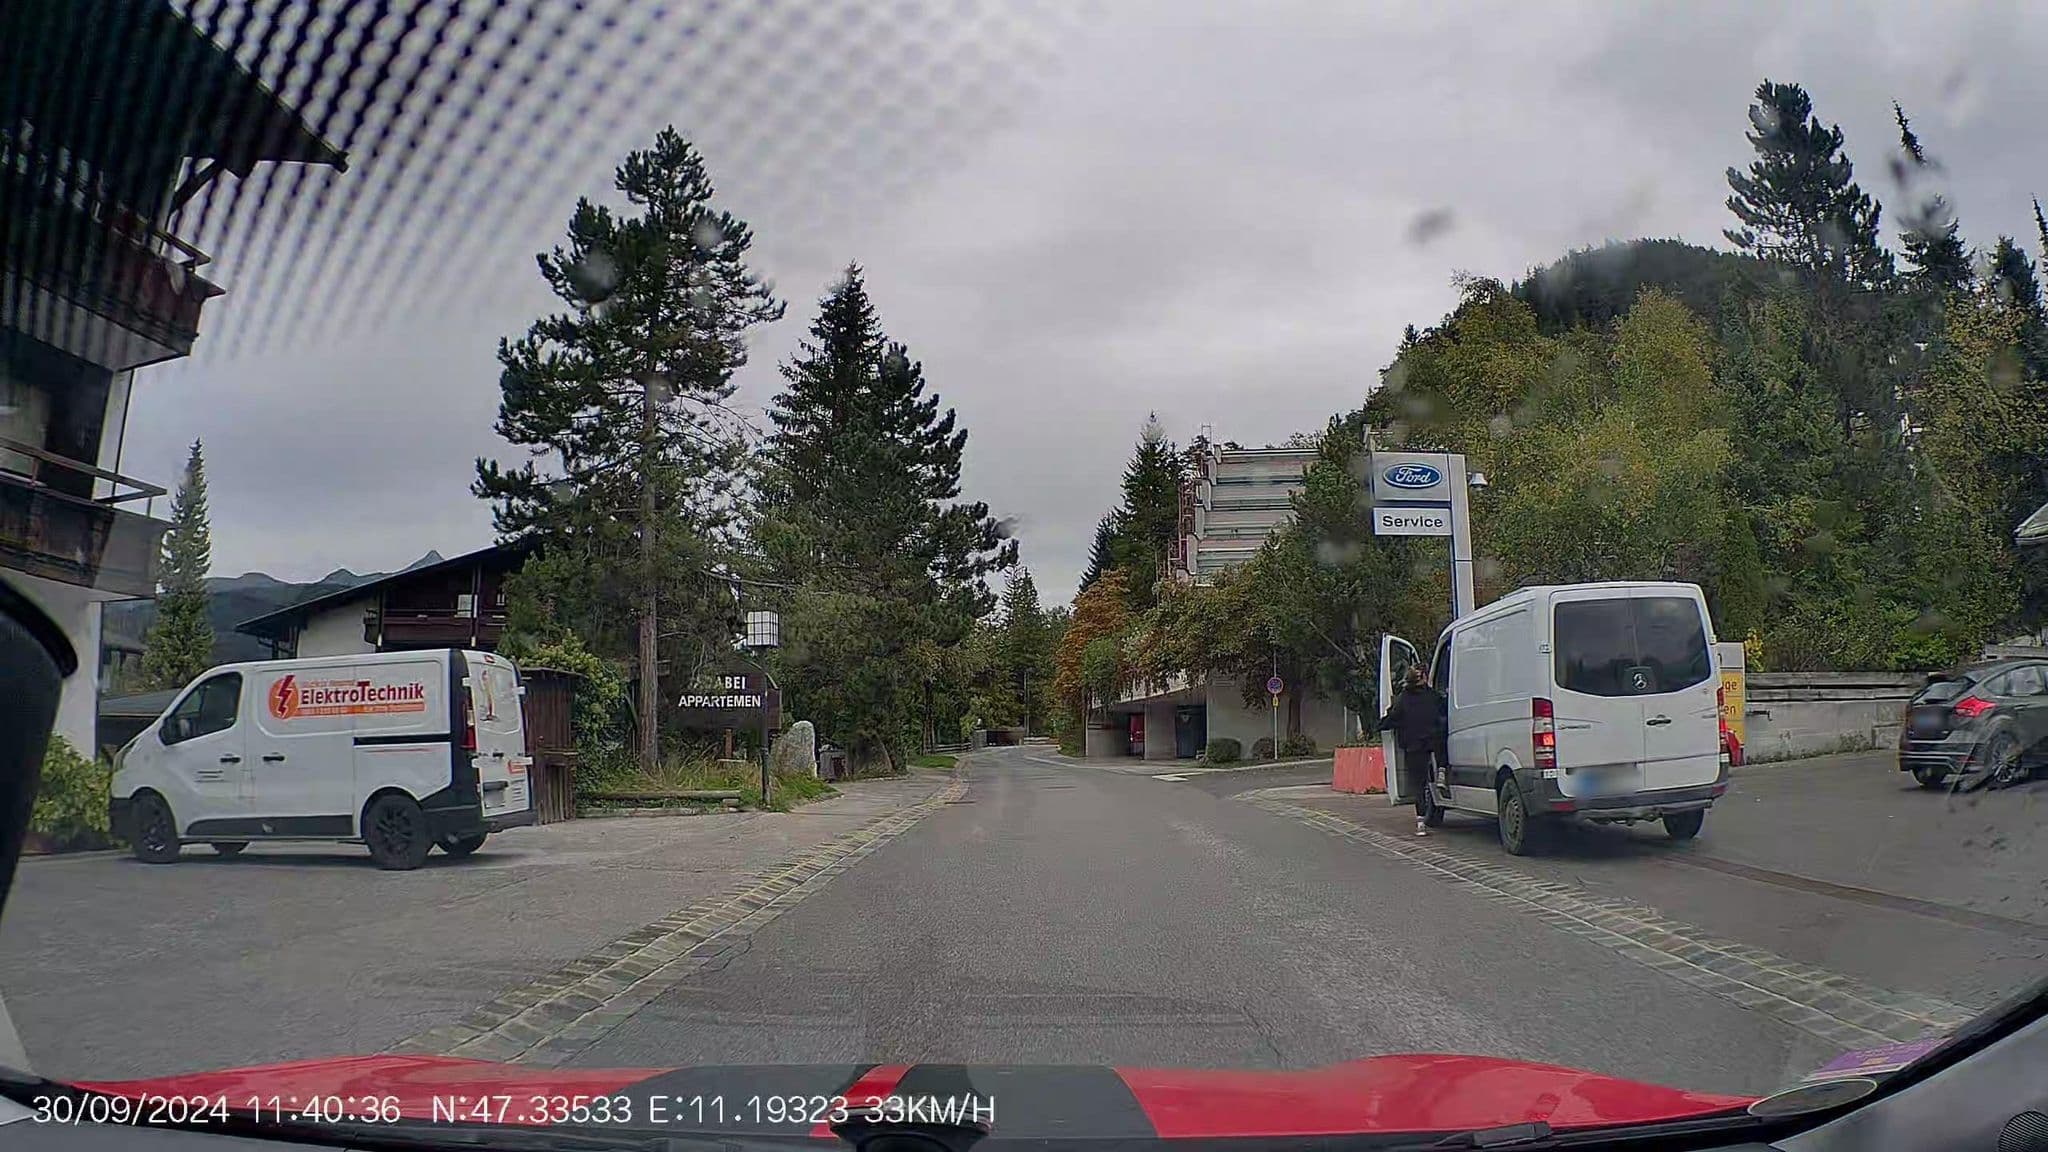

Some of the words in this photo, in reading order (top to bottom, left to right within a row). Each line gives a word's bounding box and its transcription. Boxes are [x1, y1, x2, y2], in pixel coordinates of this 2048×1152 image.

[1395, 466, 1431, 483] Ford
[1382, 515, 1443, 528] Service
[301, 681, 424, 705] ElektroTechnik
[678, 695, 766, 708] APPARTEMEN
